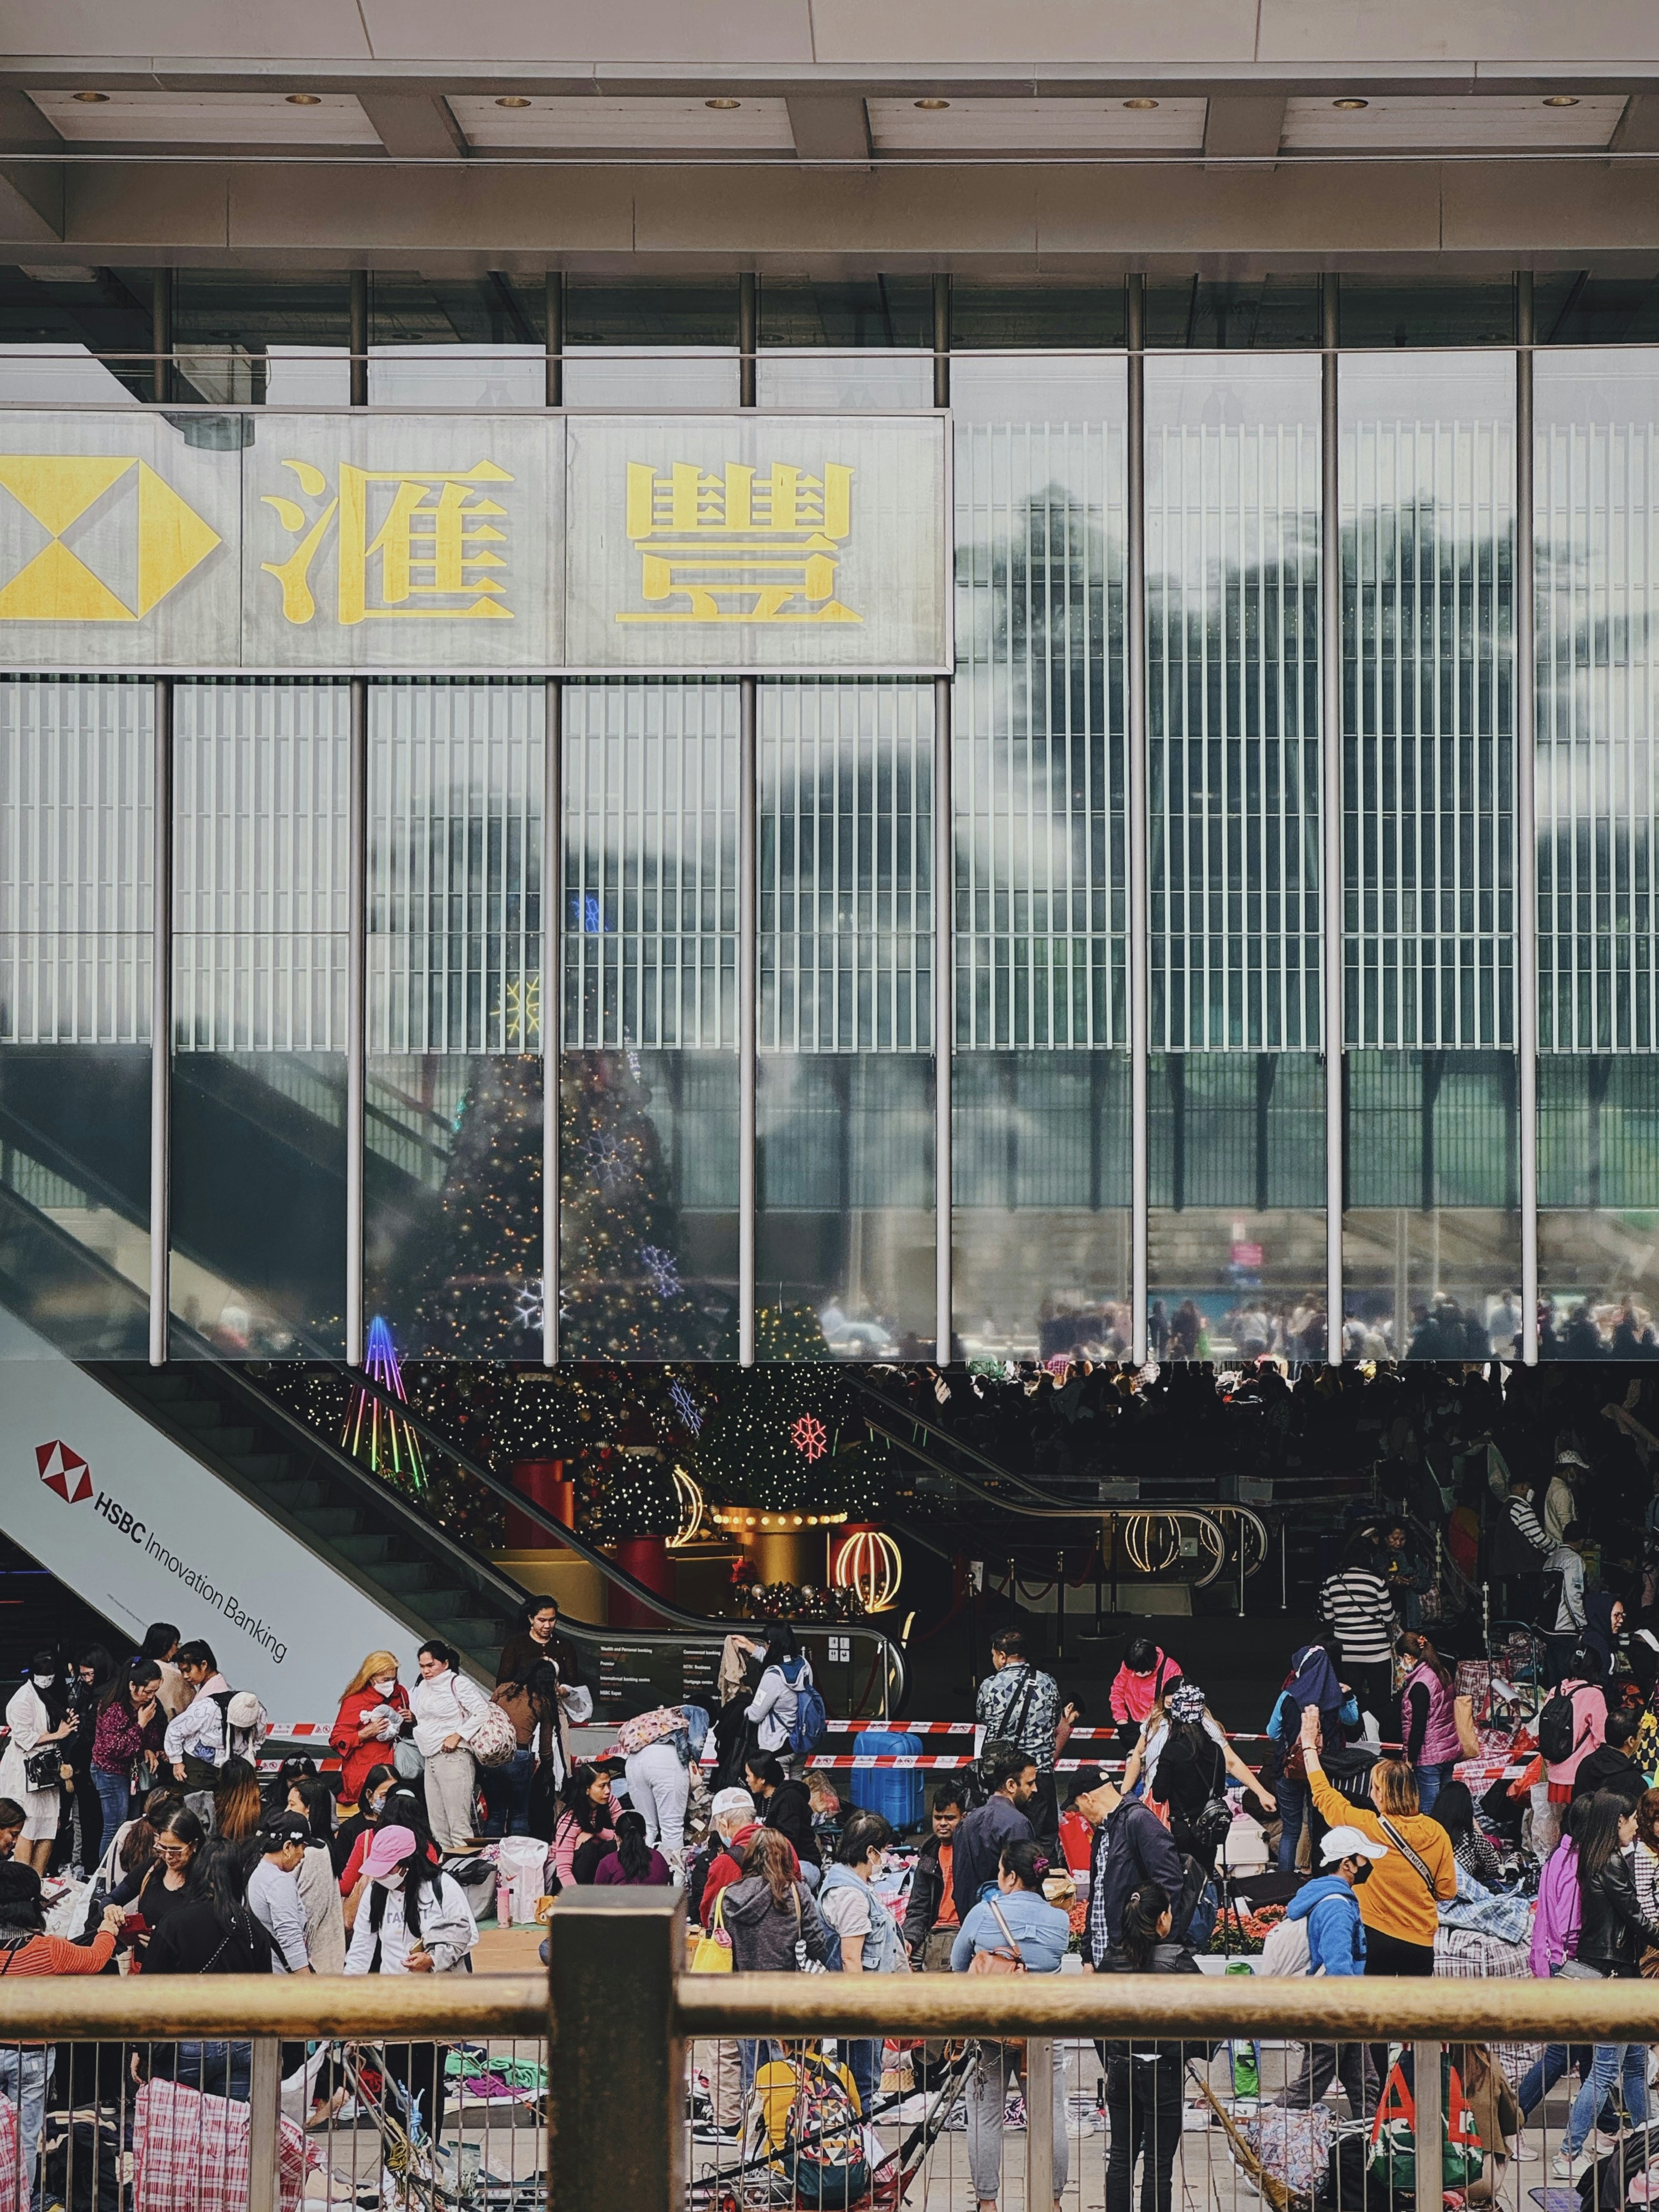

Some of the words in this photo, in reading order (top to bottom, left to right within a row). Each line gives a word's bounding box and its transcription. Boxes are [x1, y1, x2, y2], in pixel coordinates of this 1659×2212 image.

[94, 1492, 147, 1544] HSBC
[144, 1532, 225, 1610] Innovation
[223, 1596, 288, 1664] Banking
